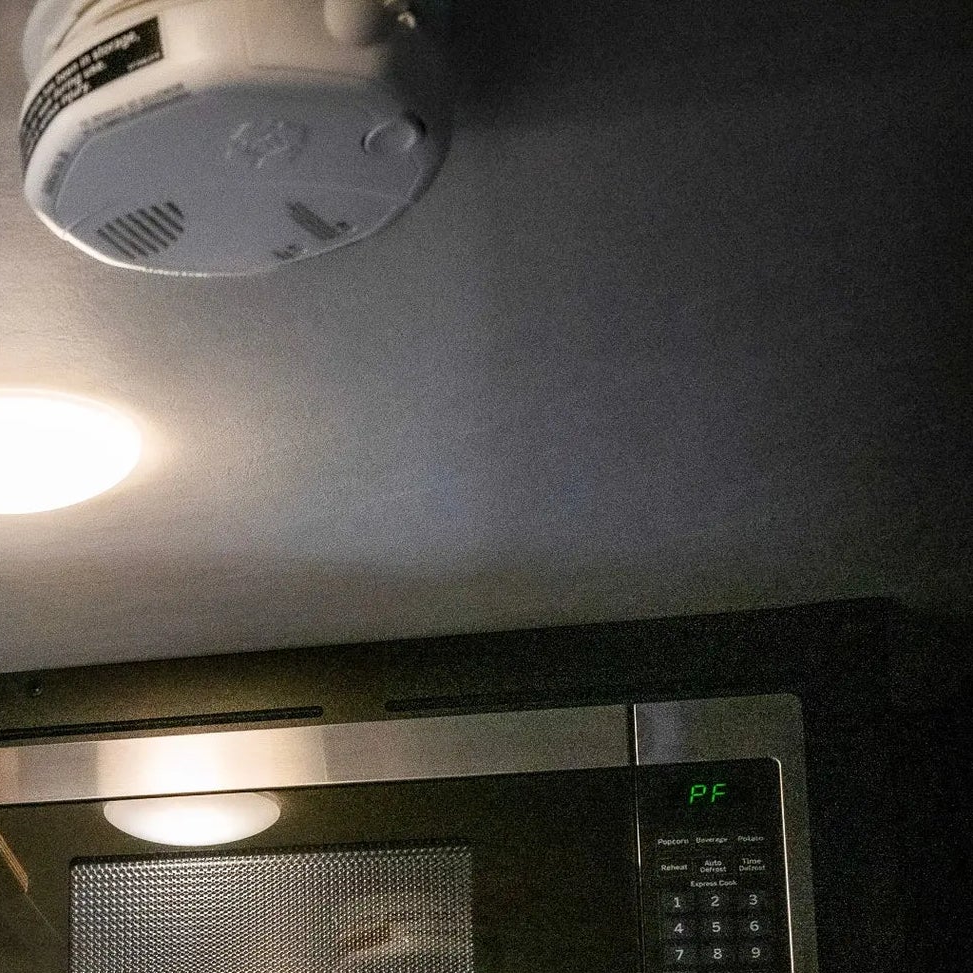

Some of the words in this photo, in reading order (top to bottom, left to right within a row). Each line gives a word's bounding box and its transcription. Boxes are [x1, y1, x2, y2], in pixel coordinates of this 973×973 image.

[690, 784, 726, 804] PF
[674, 897, 681, 908] 1
[711, 896, 720, 907] 2
[749, 895, 758, 906] 3
[674, 923, 684, 934] 4
[712, 922, 721, 933] 5
[750, 920, 759, 931] 6
[676, 950, 684, 960] 7
[713, 948, 722, 959] 8
[751, 947, 761, 958] 9
